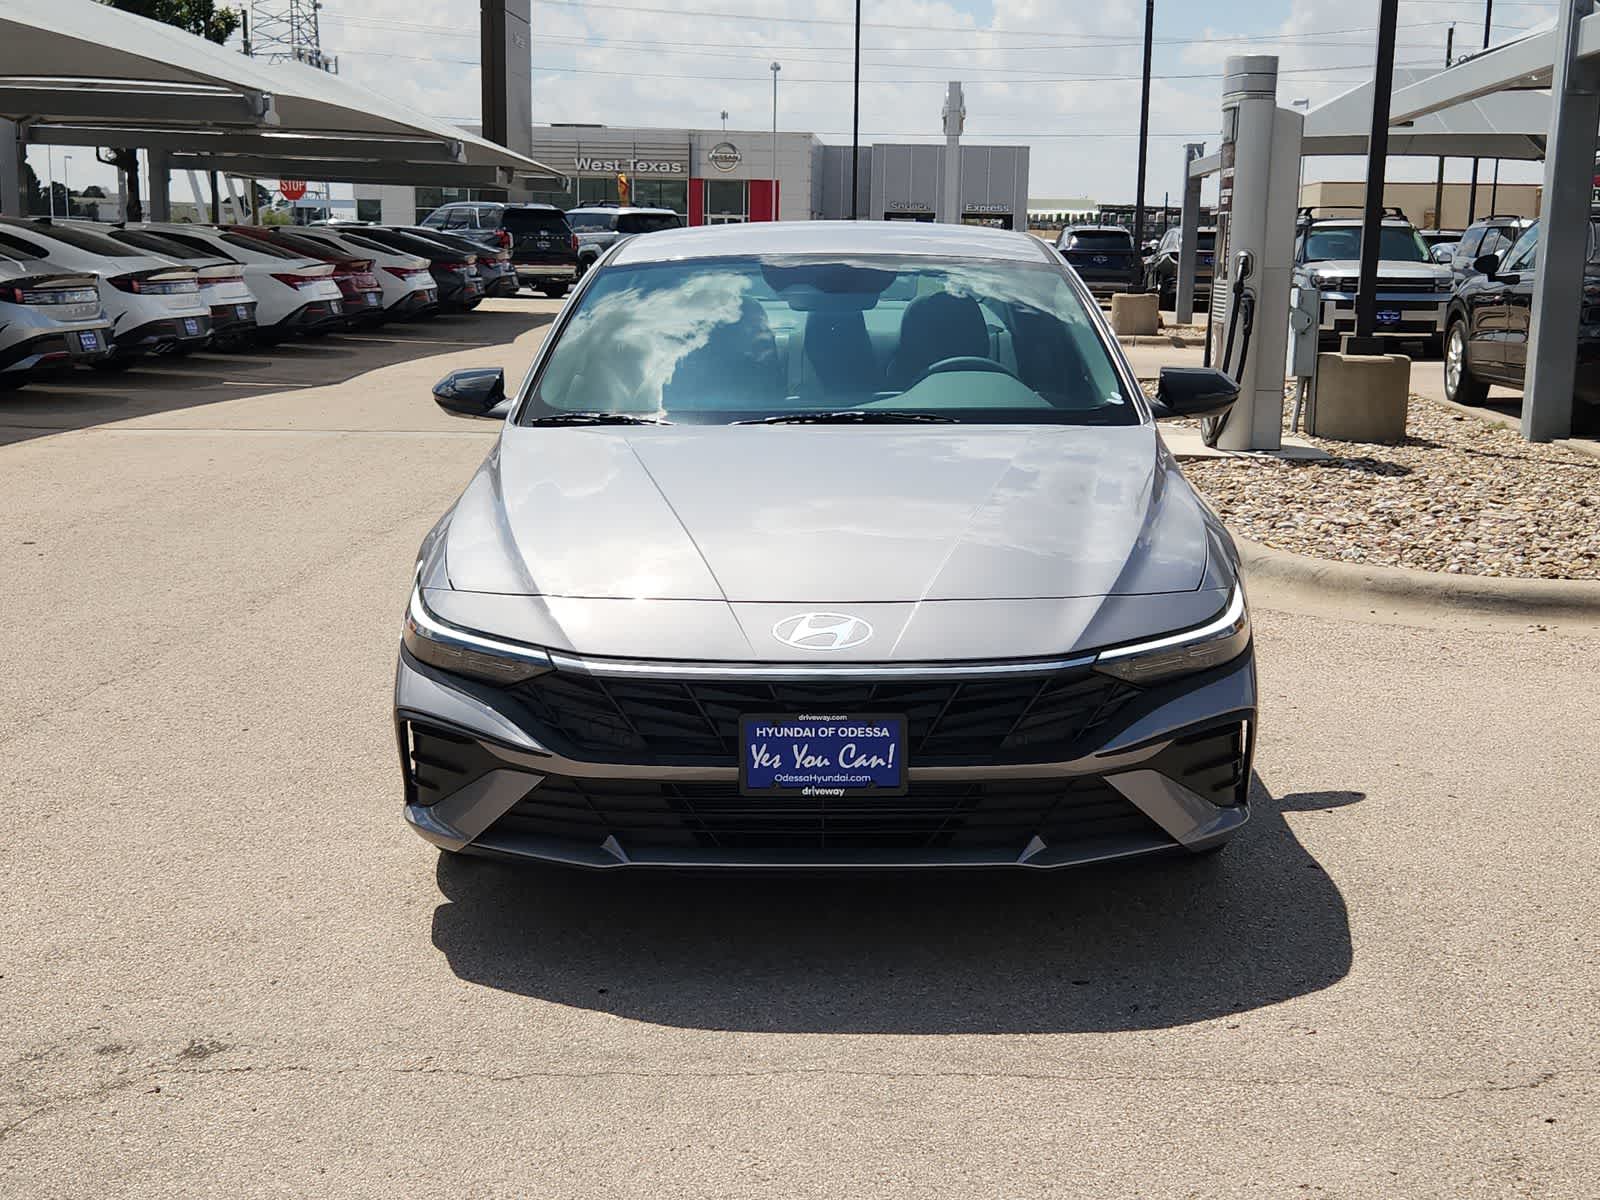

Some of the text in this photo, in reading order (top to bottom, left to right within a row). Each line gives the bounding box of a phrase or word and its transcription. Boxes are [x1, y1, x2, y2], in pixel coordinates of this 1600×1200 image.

[574, 158, 682, 173] West Texas
[281, 180, 305, 191] STOP
[798, 714, 847, 722] driveway.com
[756, 727, 890, 737] HYUNDAI OF ODESSA
[751, 743, 895, 769] Yes You Can!
[774, 773, 871, 784] OdessaHyundai.com
[802, 785, 845, 797] driveway
